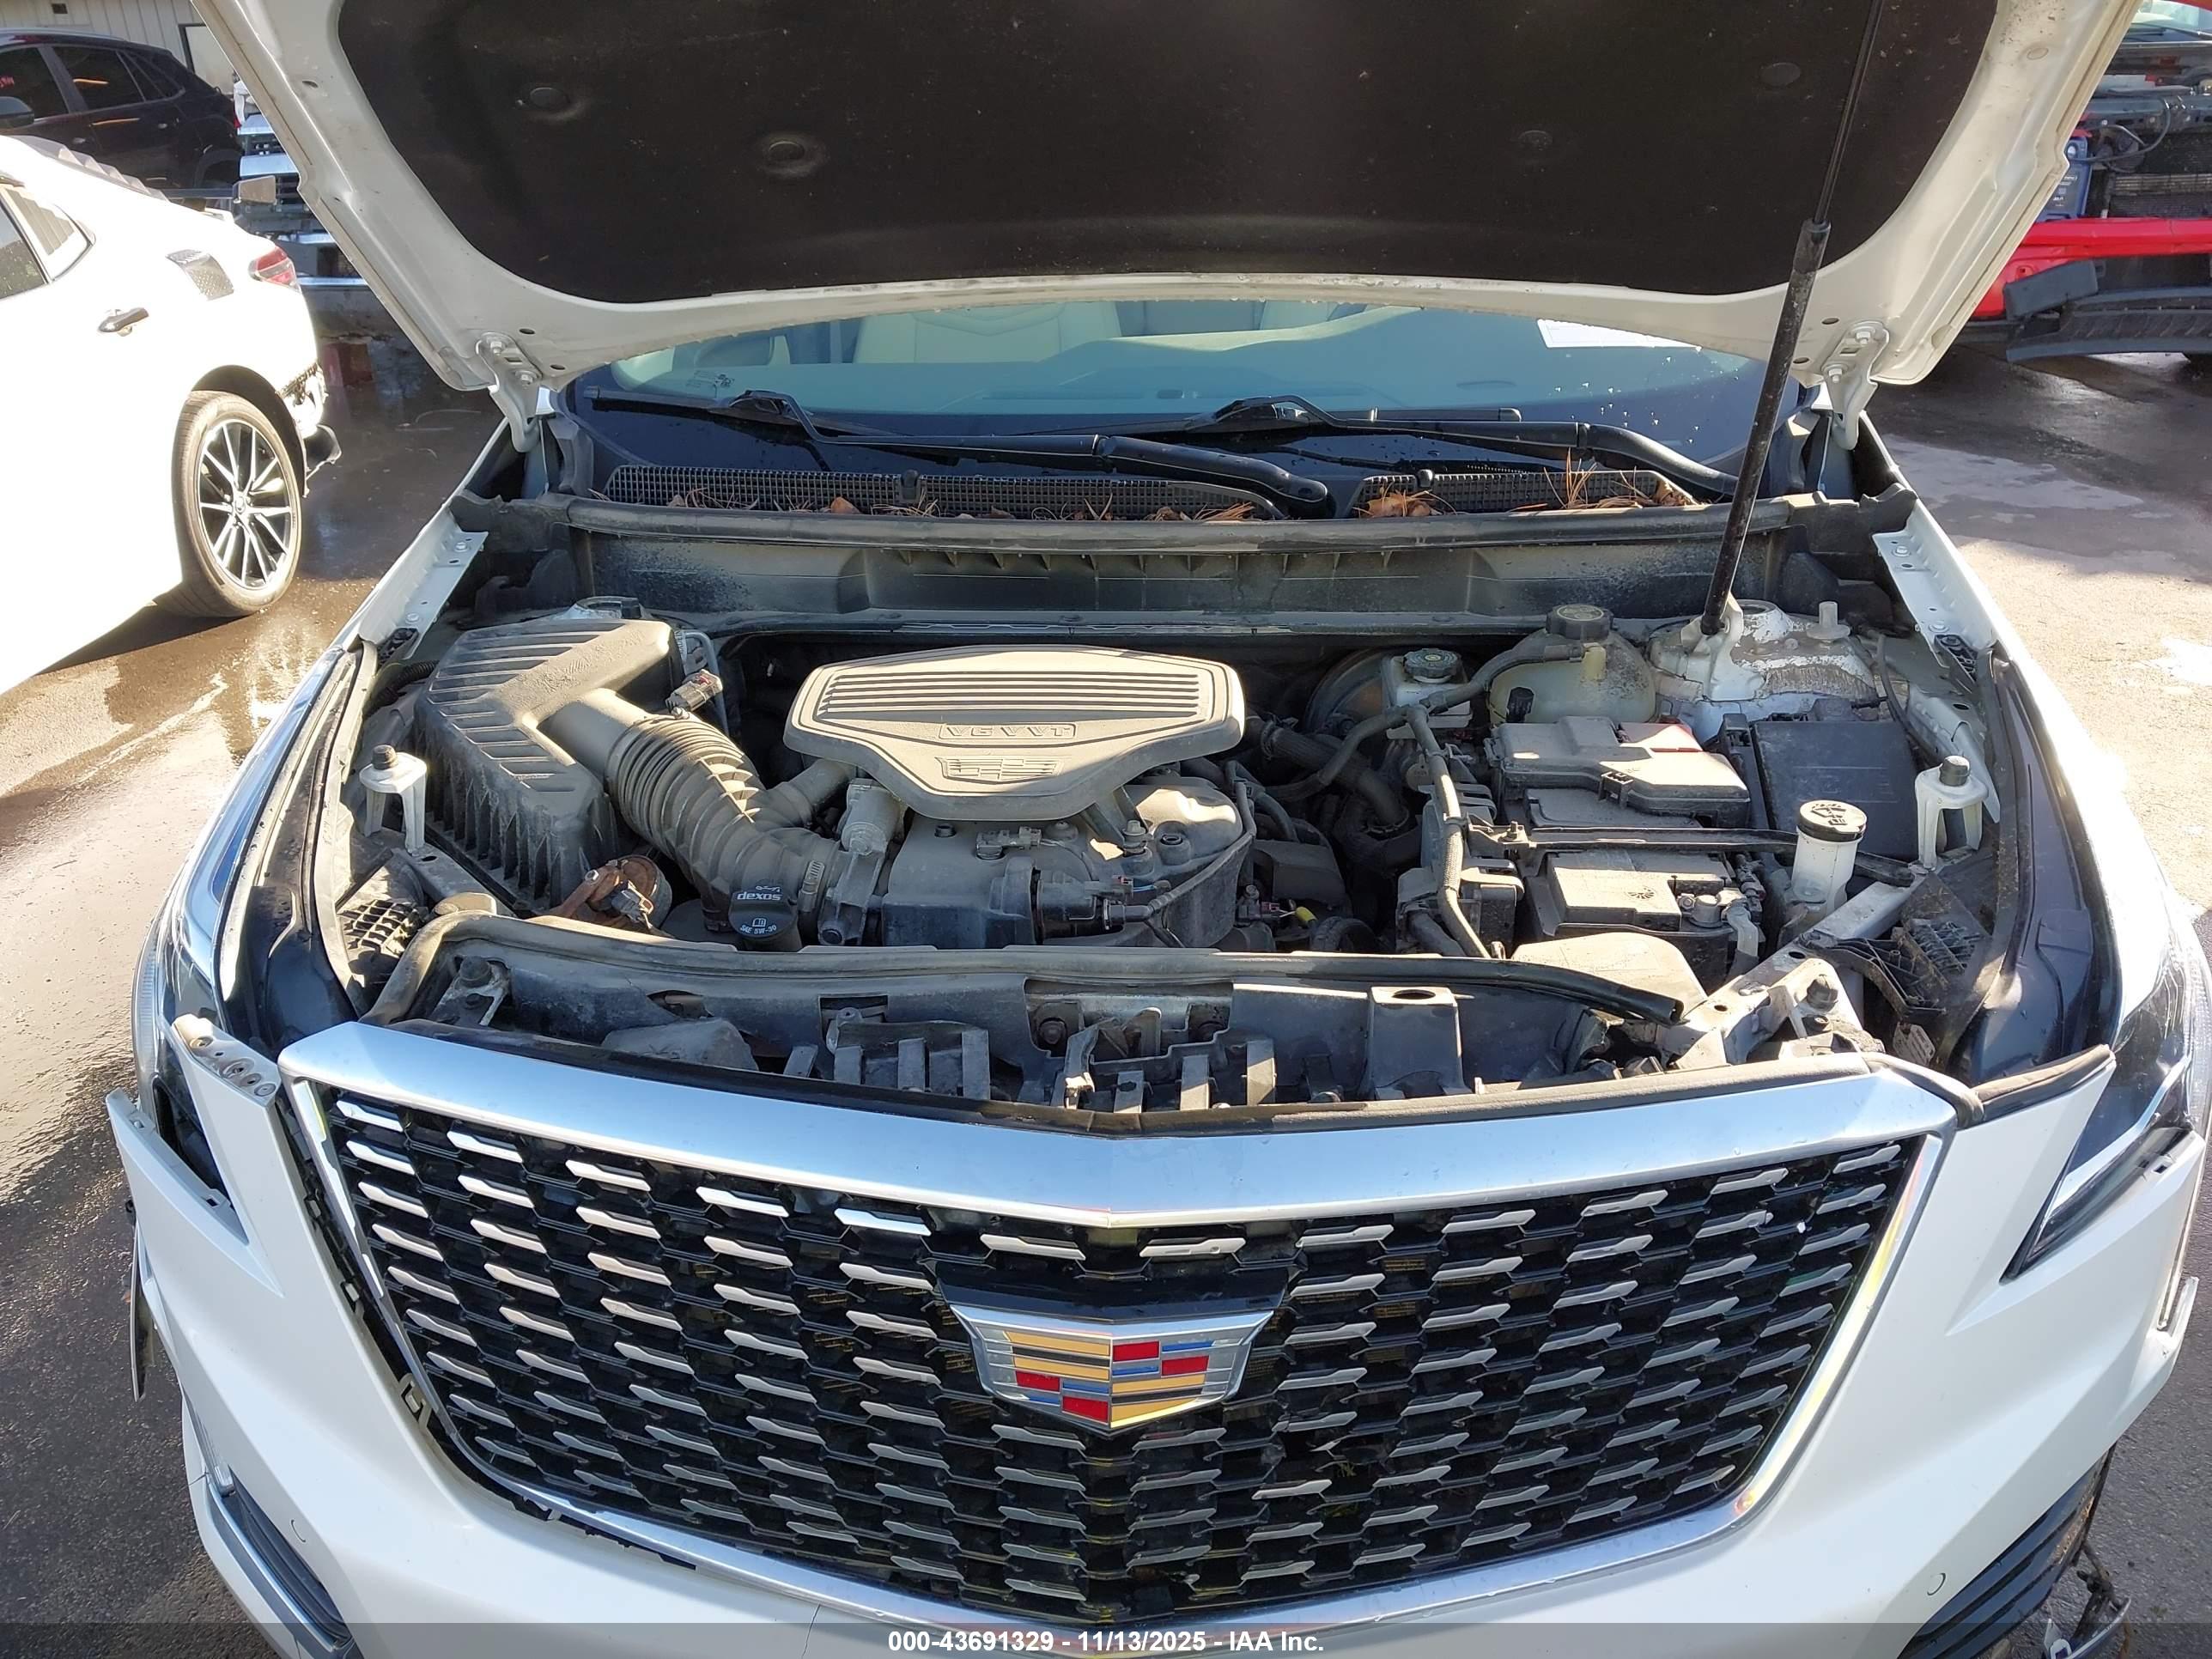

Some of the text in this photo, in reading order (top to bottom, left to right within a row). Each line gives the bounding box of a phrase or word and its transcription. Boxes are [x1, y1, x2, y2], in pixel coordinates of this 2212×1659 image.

[737, 891, 783, 901] dexos
[740, 924, 777, 934] SAE 5W-30
